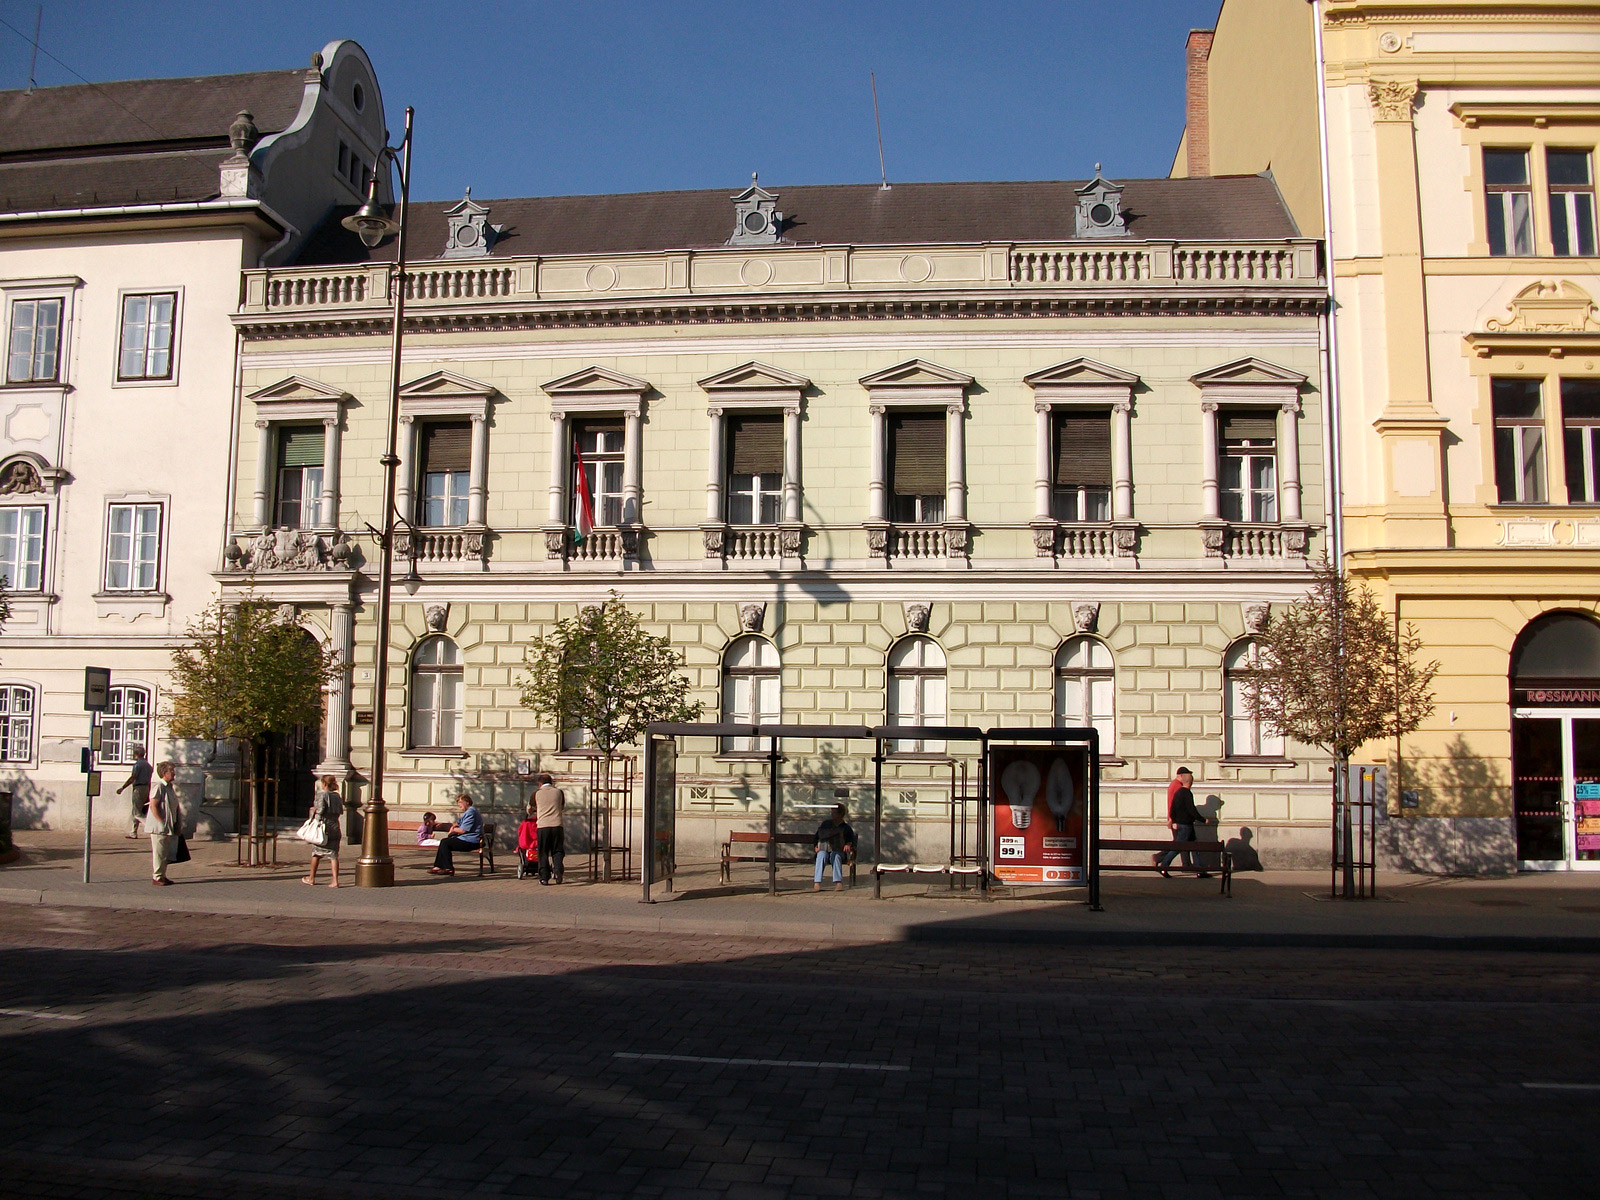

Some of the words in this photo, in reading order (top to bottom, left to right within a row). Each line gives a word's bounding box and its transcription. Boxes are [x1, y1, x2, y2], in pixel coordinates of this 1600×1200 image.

[1527, 690, 1600, 702] ROSSMANN
[1577, 785, 1589, 795] 25%
[1046, 870, 1080, 879] OBI
